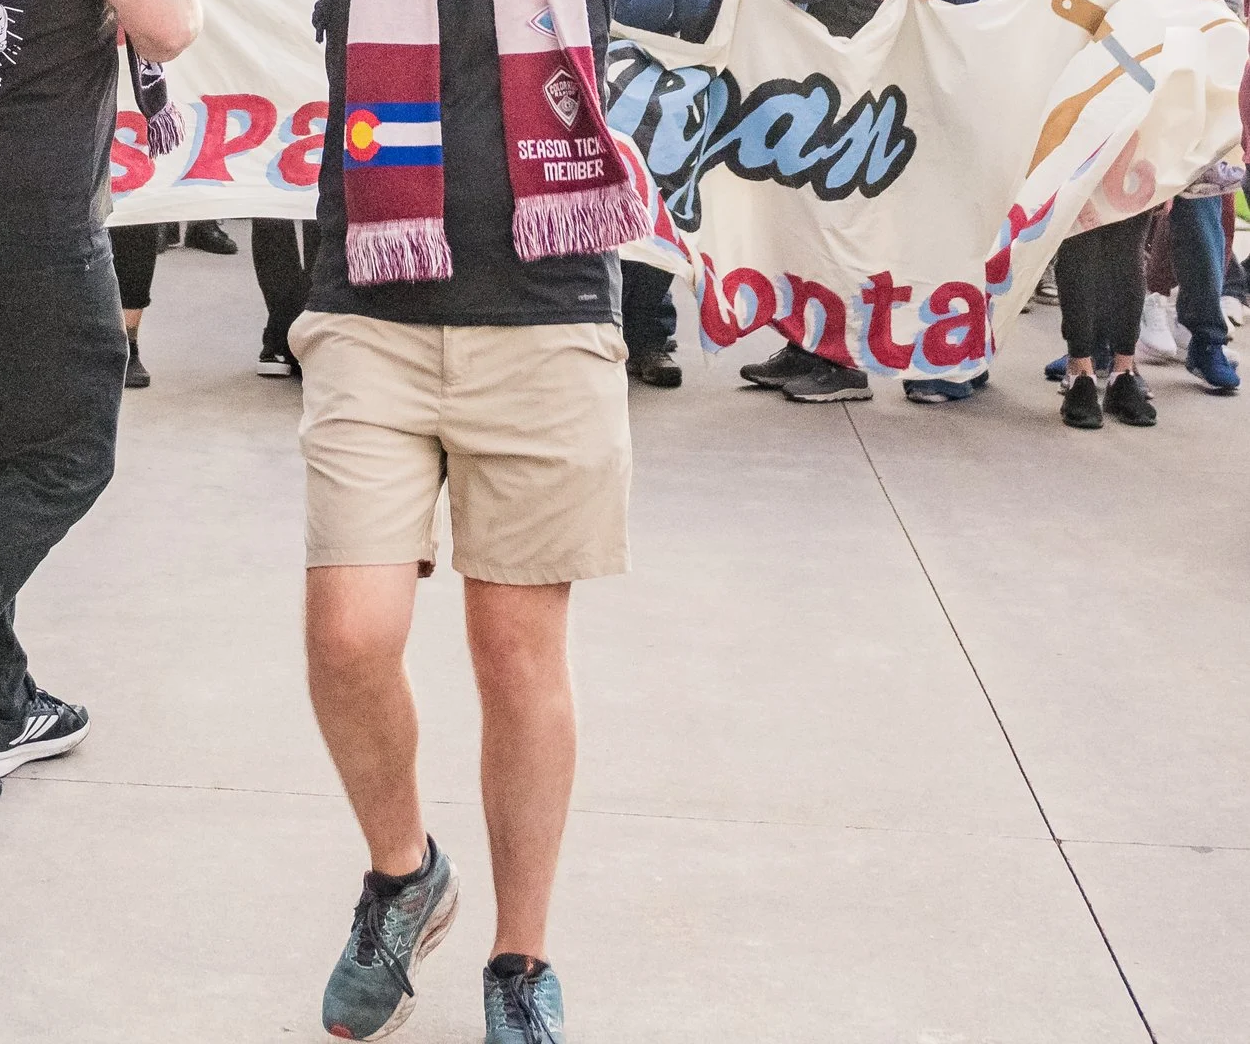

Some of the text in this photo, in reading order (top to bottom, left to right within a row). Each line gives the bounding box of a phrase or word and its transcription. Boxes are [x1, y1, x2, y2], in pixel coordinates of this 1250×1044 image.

[607, 39, 917, 233] Ryan
[517, 139, 572, 159] SEASON
[544, 159, 604, 182] MEMBER
